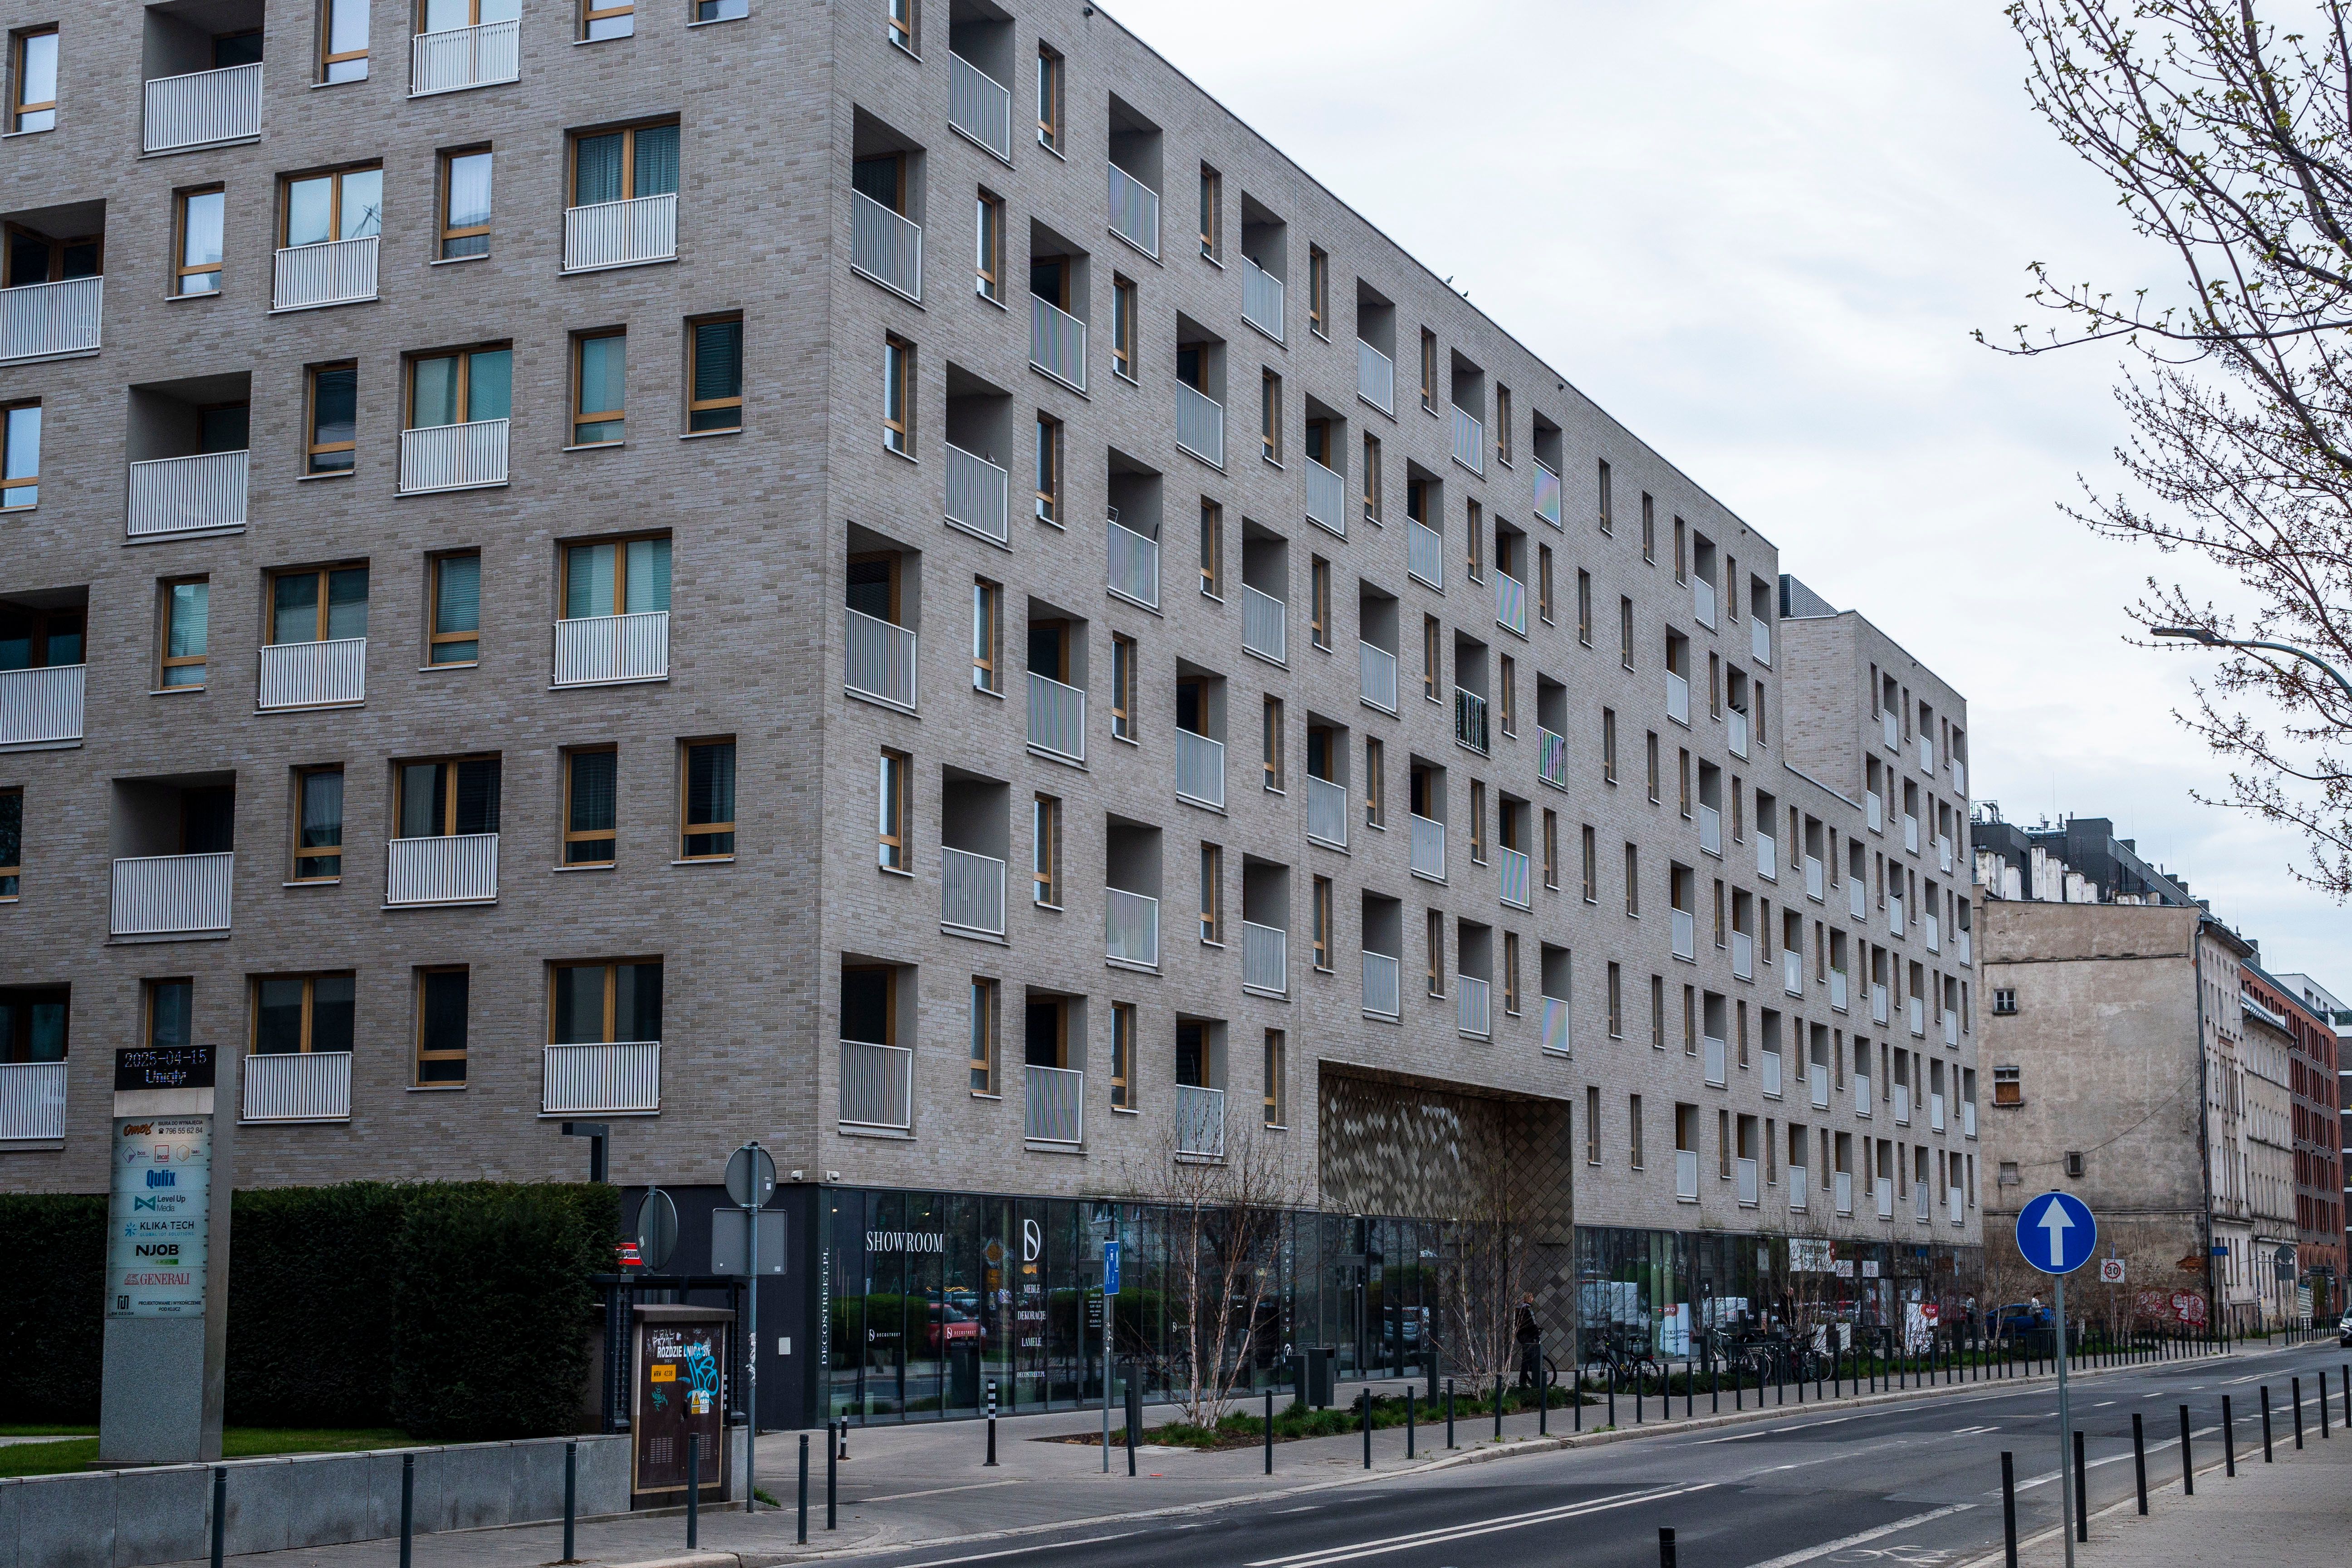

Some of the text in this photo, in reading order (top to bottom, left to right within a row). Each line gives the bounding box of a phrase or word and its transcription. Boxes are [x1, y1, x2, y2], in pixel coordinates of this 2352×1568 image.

[125, 1049, 207, 1067] 2025-04-15
[146, 1169, 176, 1189] Qulix
[176, 1195, 186, 1204] Up
[867, 1231, 943, 1252] SHOWROOM
[136, 1244, 179, 1256] NJOB
[2107, 1266, 2119, 1275] 30
[140, 1273, 190, 1285] GENERALI
[1024, 1284, 1040, 1293] MEBLE
[1018, 1310, 1046, 1321] DEKORACJE
[1022, 1337, 1042, 1346] LAMELE
